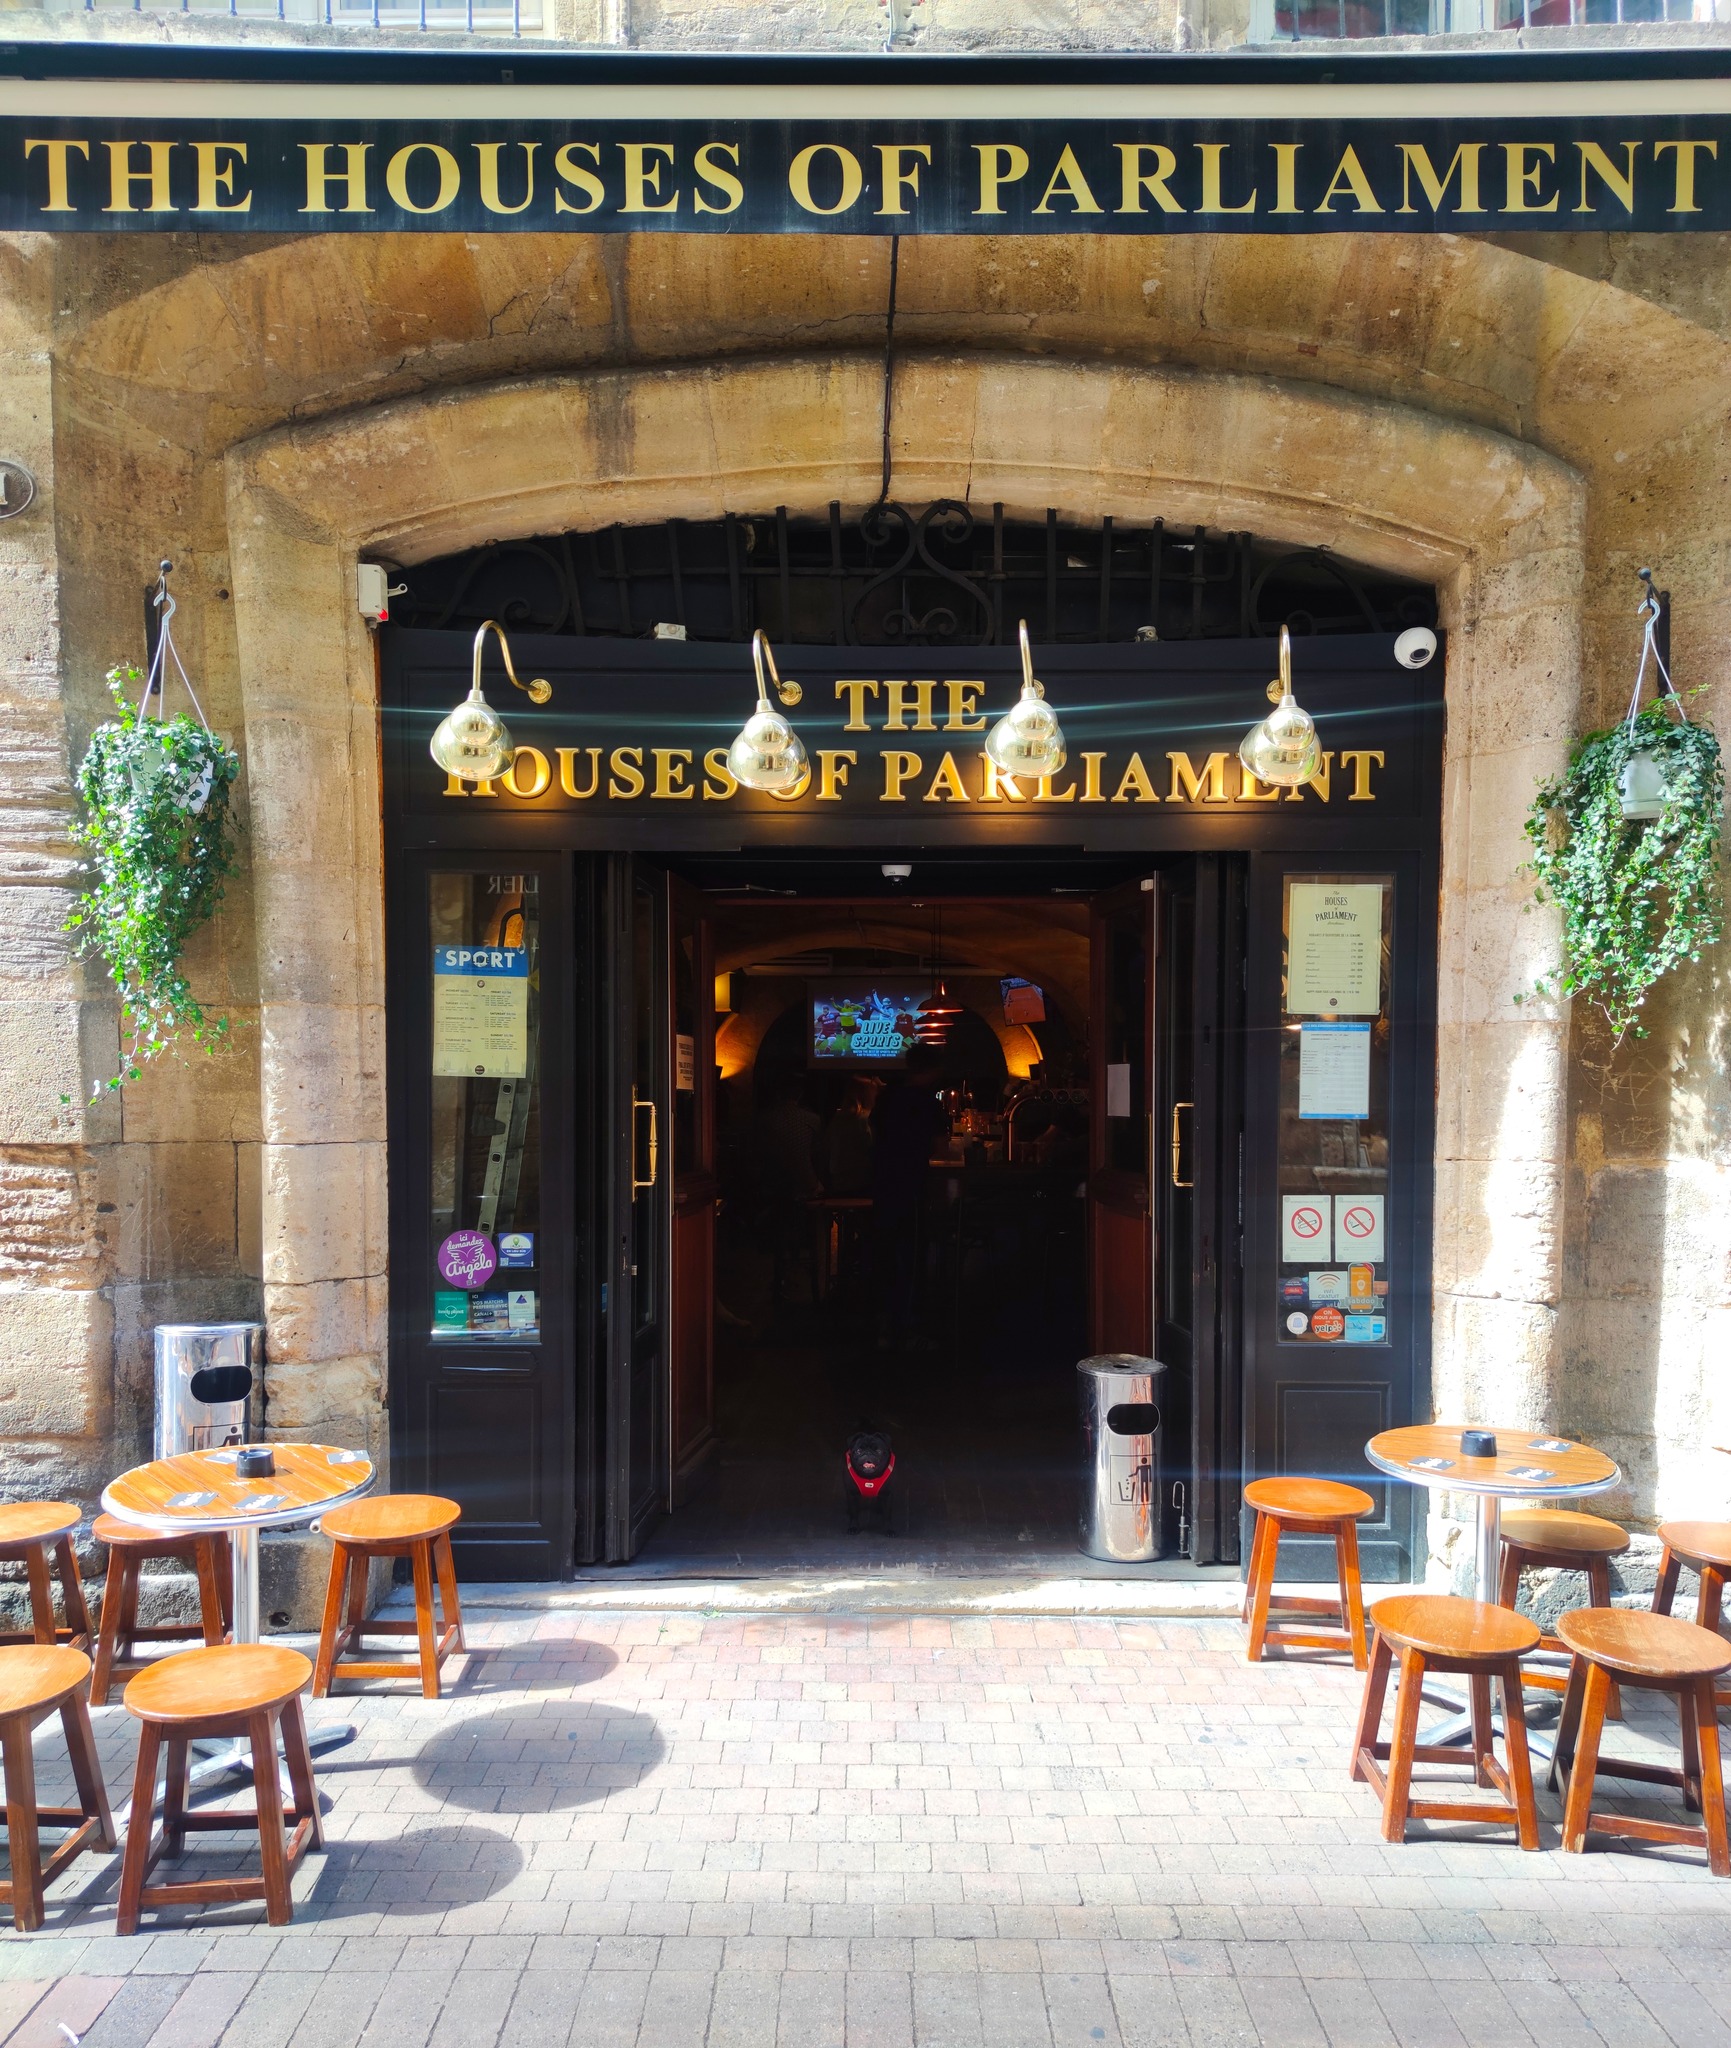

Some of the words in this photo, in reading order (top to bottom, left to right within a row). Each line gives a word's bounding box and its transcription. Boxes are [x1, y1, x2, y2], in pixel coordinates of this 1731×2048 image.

[24, 139, 252, 216] THE
[297, 142, 744, 214] HOUSES
[788, 143, 932, 217] OF
[971, 140, 1718, 215] PARLIAMENT
[834, 679, 988, 731] THE
[764, 750, 858, 802] F
[879, 749, 1386, 803] PARLIAMENT
[1324, 896, 1348, 906] HOUSES
[1315, 911, 1358, 922] PARLIAMENT
[445, 950, 516, 968] SPORT
[862, 1022, 891, 1034] LIVE
[853, 1035, 901, 1047] SPORTS
[447, 1236, 484, 1250] demandez
[446, 1253, 493, 1280] Angela
[1315, 1324, 1333, 1333] yelp
